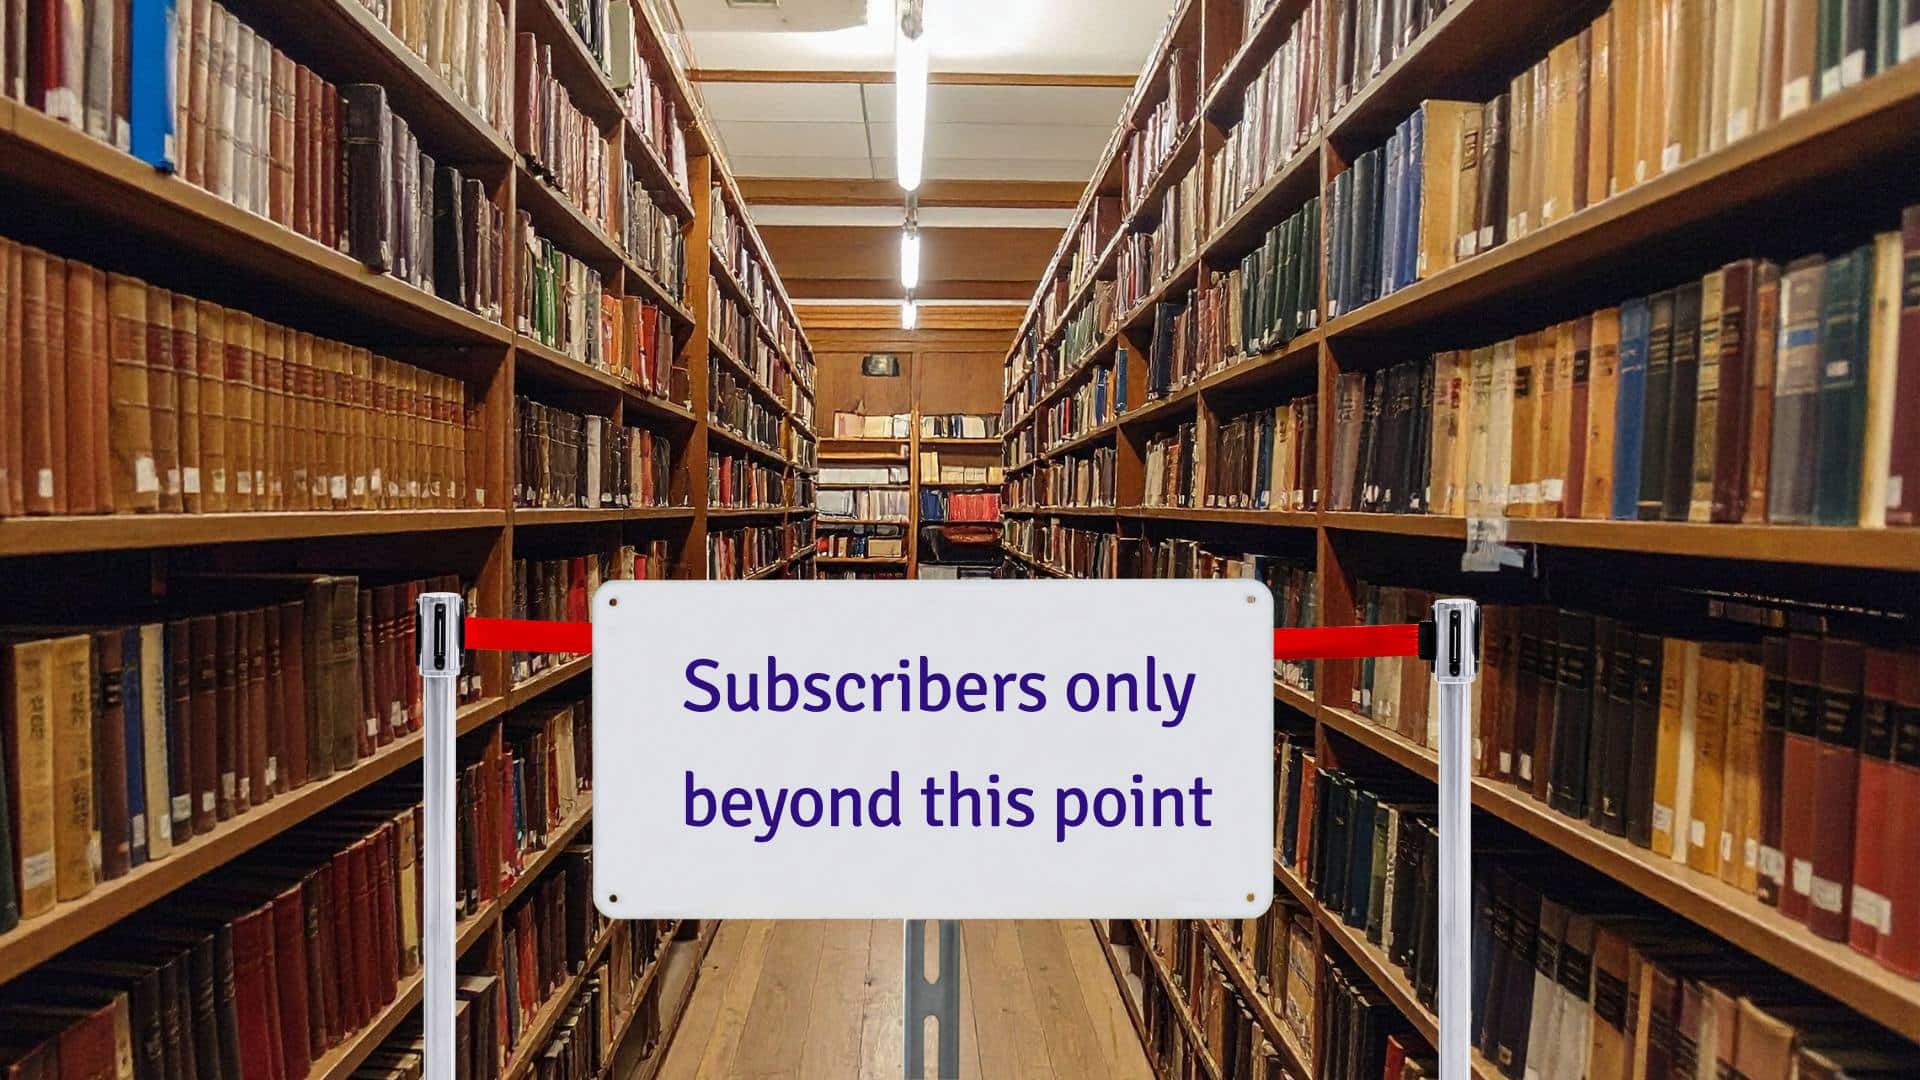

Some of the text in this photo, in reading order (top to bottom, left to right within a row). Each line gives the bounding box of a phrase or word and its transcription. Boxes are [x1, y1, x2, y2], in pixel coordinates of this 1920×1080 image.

[683, 655, 1197, 729] Subscribers only
[685, 770, 1213, 843] beyond this point
